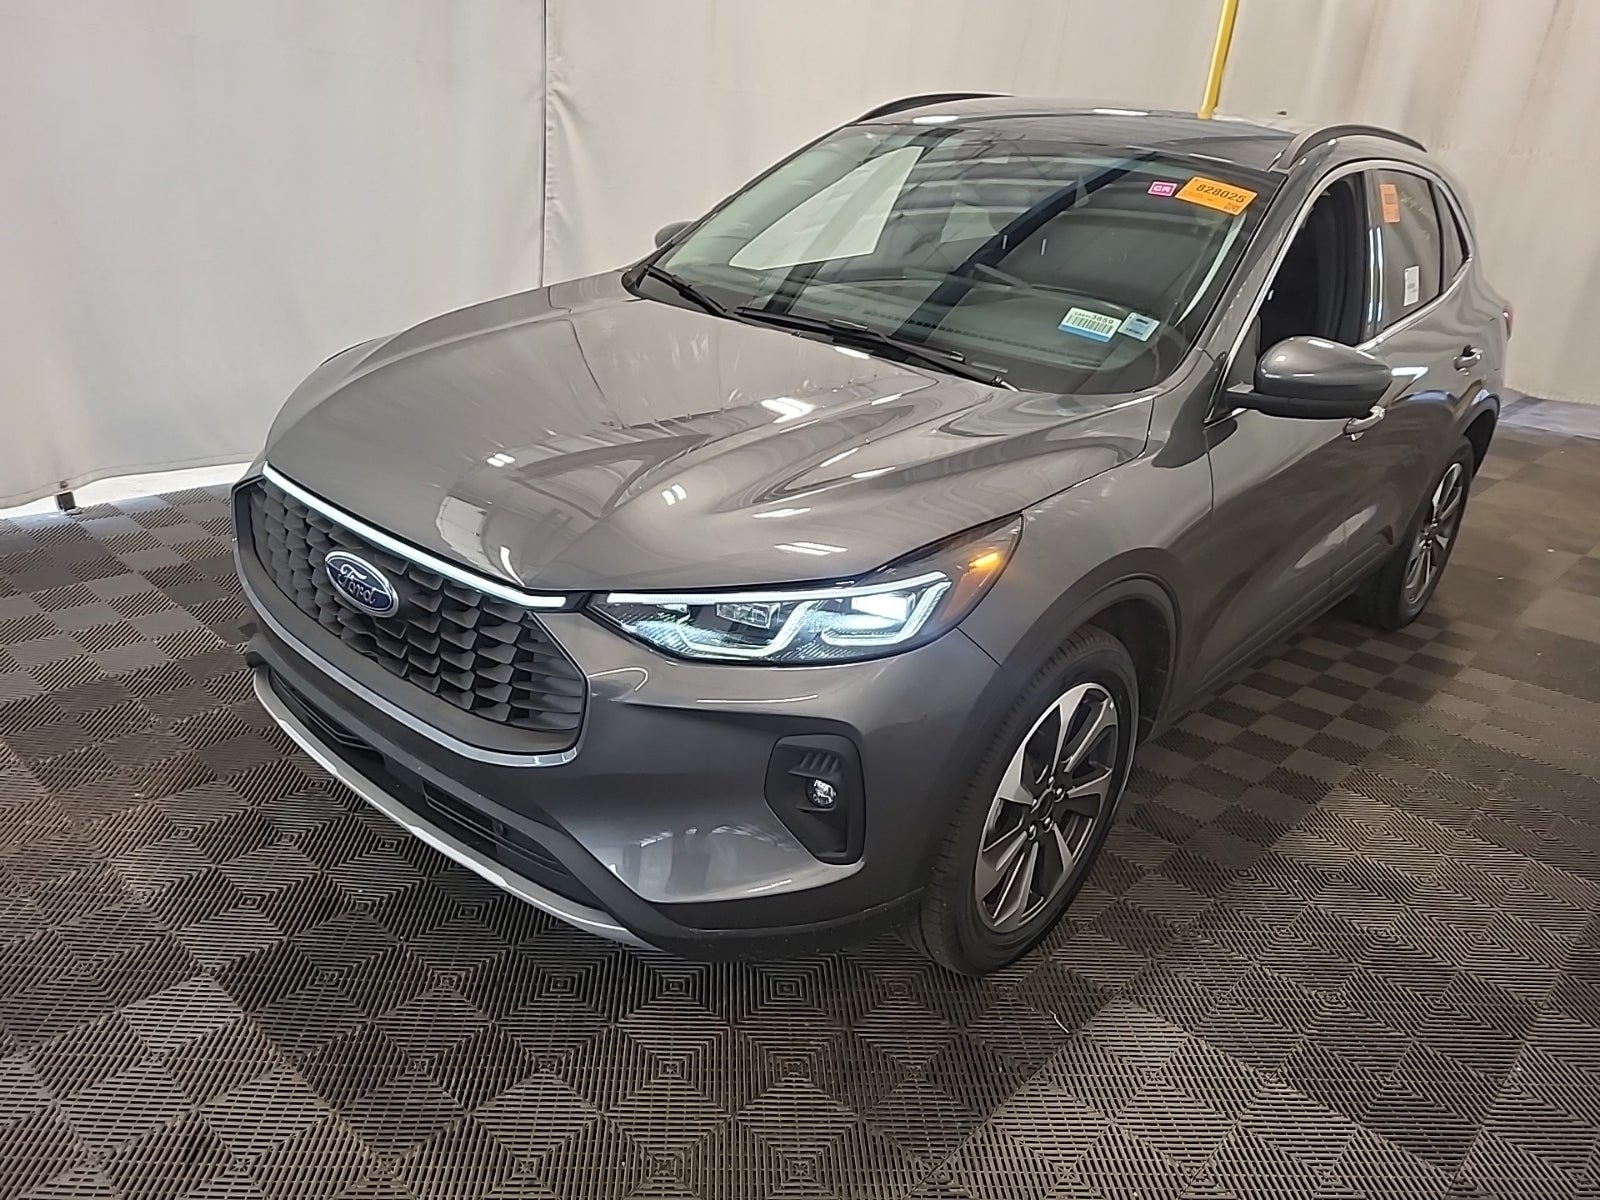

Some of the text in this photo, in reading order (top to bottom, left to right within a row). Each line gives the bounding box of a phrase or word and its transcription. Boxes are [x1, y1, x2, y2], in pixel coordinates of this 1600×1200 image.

[1153, 184, 1171, 193] CR
[1195, 184, 1247, 203] 828025
[337, 563, 376, 604] Ford
